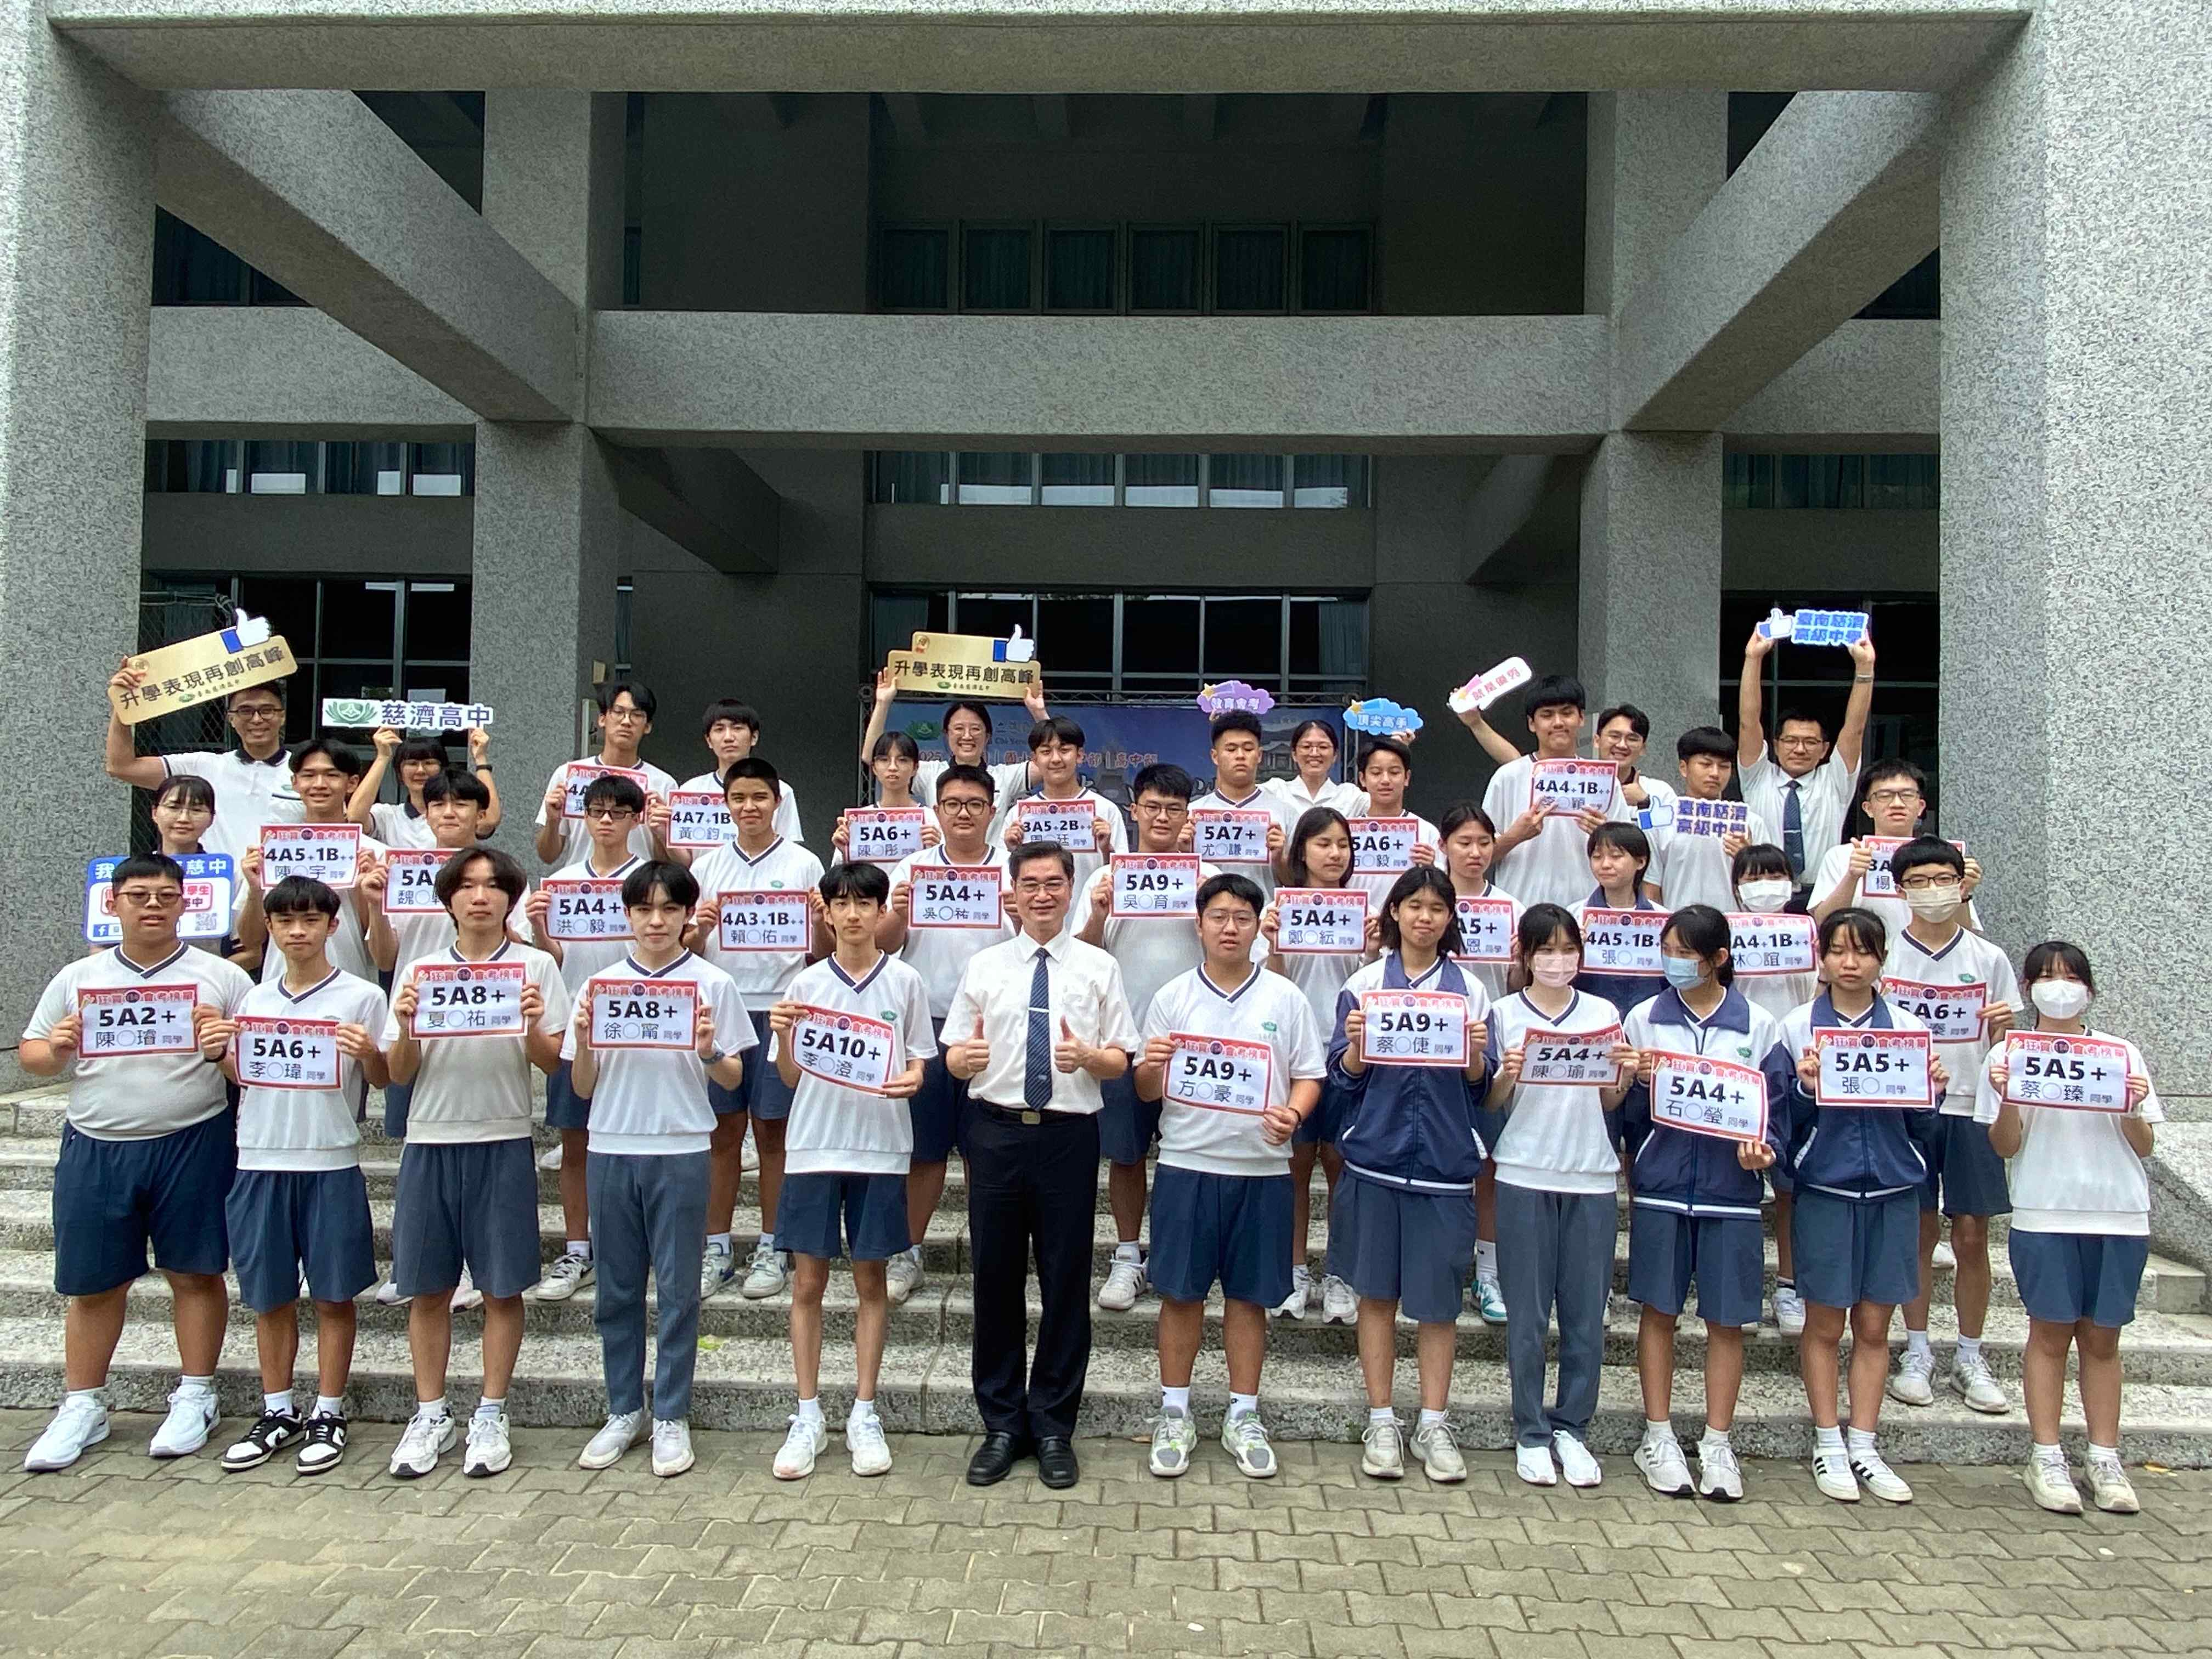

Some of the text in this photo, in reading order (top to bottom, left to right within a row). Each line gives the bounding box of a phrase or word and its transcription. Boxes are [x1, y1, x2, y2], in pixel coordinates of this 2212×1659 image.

[120, 646, 285, 709] 升學表現再創高峰
[894, 659, 1034, 685] 升學表現再創高峰
[381, 703, 490, 728] 慈濟高中
[1357, 714, 1408, 729] 頂尖高手
[1678, 799, 1748, 821] 臺南慈濟
[860, 826, 911, 842] 5A6+
[1204, 826, 1256, 840] 5A7+
[1351, 836, 1404, 853] 5A6+
[265, 847, 354, 862] 4A5+1B++
[1126, 874, 1184, 891] 5A9+
[926, 885, 985, 902] 5A4+
[558, 898, 622, 916] 5A4+
[723, 911, 805, 926] 4A3+1B++
[1290, 909, 1351, 927] 5A4+
[1457, 918, 1498, 936] A5+
[1733, 933, 1809, 949] A4+1B++
[431, 986, 506, 1007] 5A8+
[99, 1007, 176, 1027] 5A2+
[607, 1000, 678, 1019] 5A8+
[1897, 1000, 1967, 1020] 5A6+
[491, 1015, 512, 1025] 同學
[1380, 1012, 1449, 1032] 5A9+
[163, 1035, 183, 1044] 同學
[664, 1029, 682, 1040] 同學
[253, 1038, 321, 1059] 5A6+
[801, 1028, 881, 1061] 5A10+
[1434, 1045, 1453, 1054] 同學
[1537, 1047, 1607, 1062] 5A4+
[1835, 1052, 1910, 1073] 5A5+
[306, 1070, 326, 1081] 同學
[1184, 1056, 1252, 1082] 5A9+
[2024, 1057, 2108, 1081] 5A5+
[1669, 1075, 1746, 1103] 5A4+
[1886, 1084, 1907, 1095] 同學
[1235, 1094, 1255, 1105] 同學
[2089, 1093, 2113, 1104] 同學
[1728, 1116, 1749, 1129] 同學
